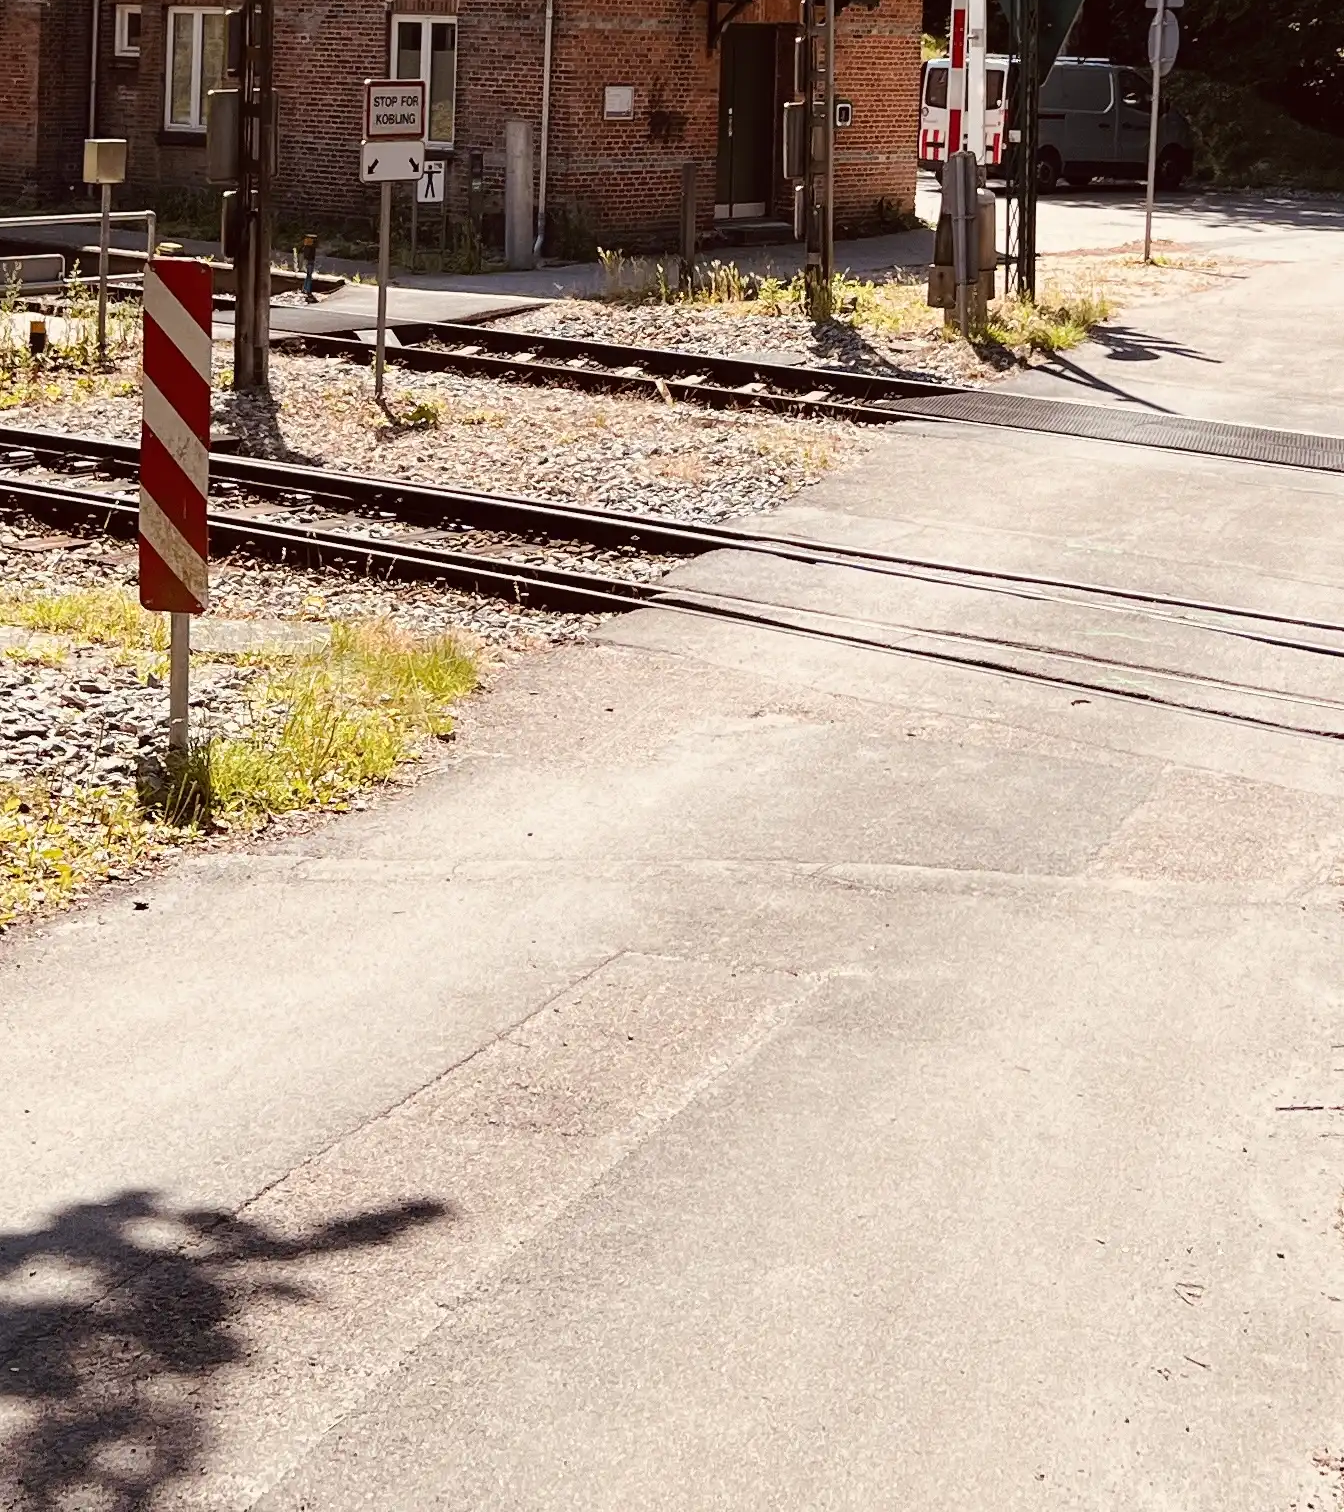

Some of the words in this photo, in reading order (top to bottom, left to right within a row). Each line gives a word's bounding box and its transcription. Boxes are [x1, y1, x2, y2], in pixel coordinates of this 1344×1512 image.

[373, 96, 397, 107] STOP
[401, 95, 419, 107] FOR
[376, 113, 415, 125] KOBLING
